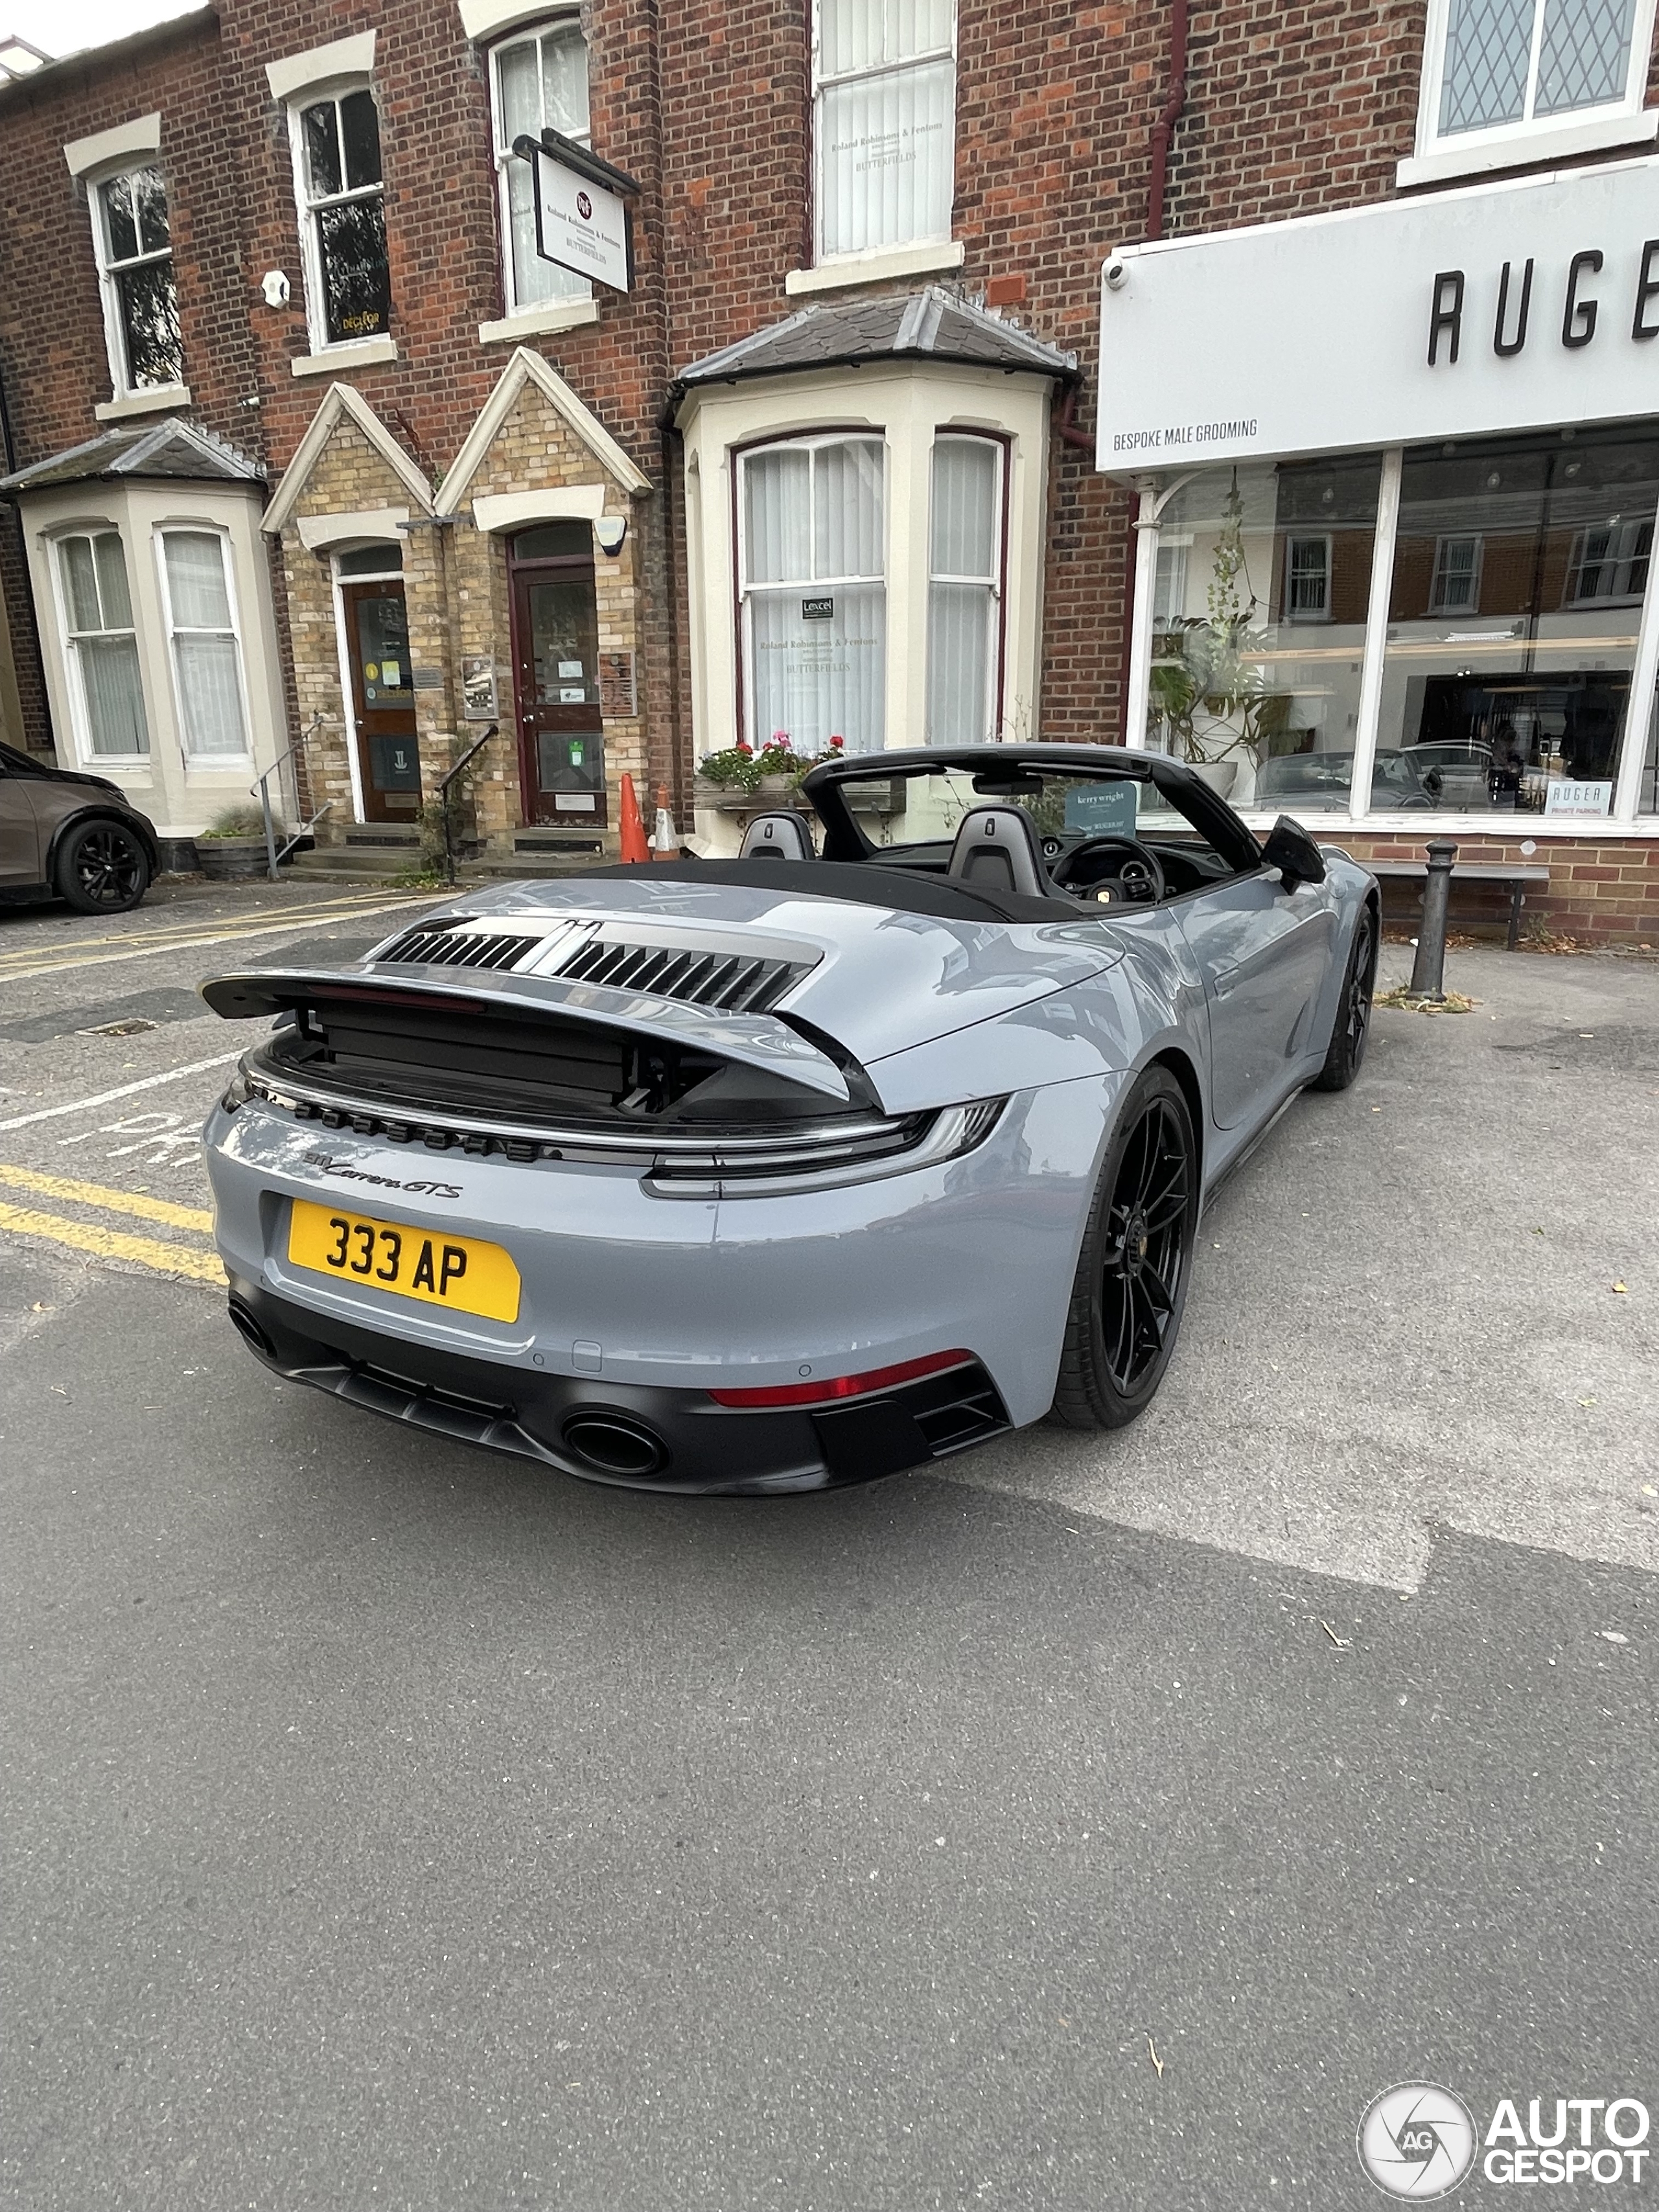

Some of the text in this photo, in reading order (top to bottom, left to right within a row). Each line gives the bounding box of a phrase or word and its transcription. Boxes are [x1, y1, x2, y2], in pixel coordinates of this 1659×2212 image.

[831, 139, 858, 152] Roland
[860, 132, 899, 146] Robinsons
[902, 128, 909, 137] &
[911, 122, 943, 136] Fentons
[856, 150, 916, 172] BUTTERFIELDS
[566, 237, 607, 265] BUTTERFIELDS
[1113, 419, 1258, 451] BESPOKE MALE GROOMING
[760, 638, 878, 649] Roland Robinsons & Fentons
[787, 663, 850, 673] BUTTERFIELDS
[321, 1163, 401, 1189] Carrera
[401, 1181, 464, 1198] GTS
[327, 1217, 468, 1296] 333 AP
